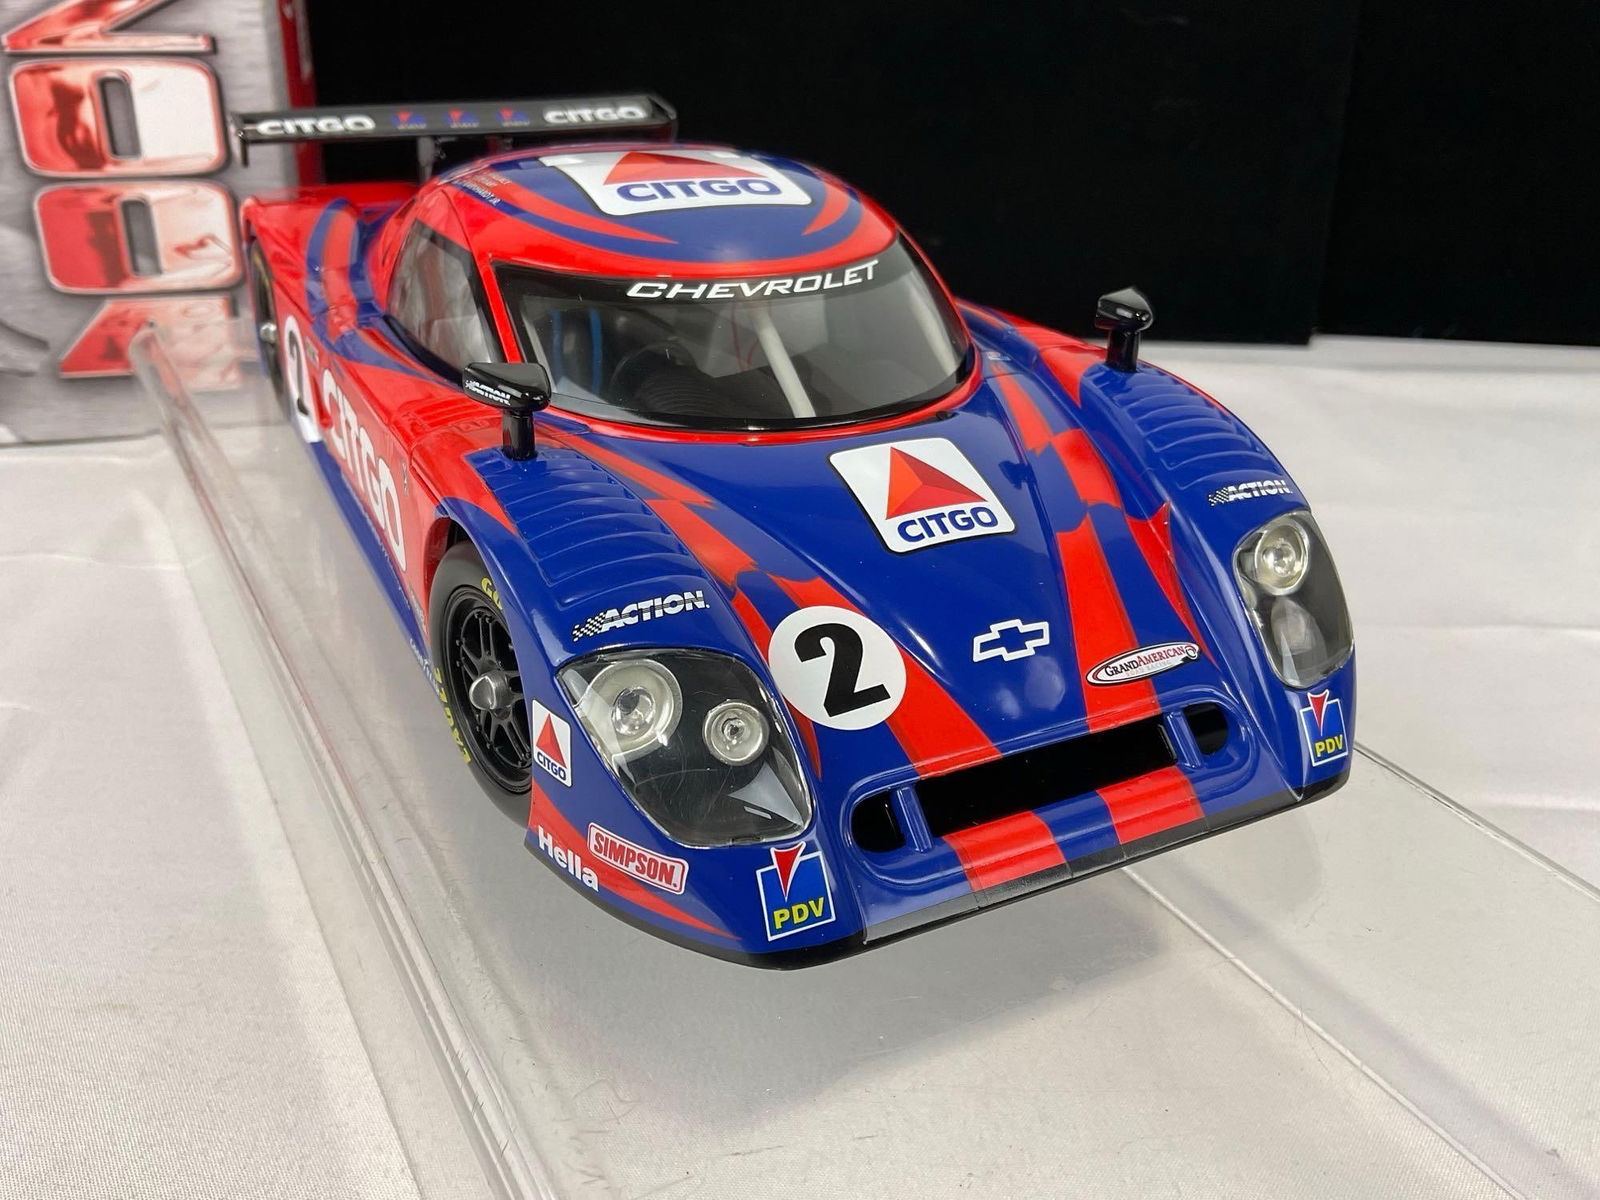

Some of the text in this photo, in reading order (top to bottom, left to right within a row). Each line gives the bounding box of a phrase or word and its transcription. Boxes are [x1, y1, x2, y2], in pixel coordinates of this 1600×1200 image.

[256, 115, 376, 136] CITGO
[544, 105, 647, 124] CITGO
[617, 178, 782, 202] CITGO
[626, 260, 879, 300] CHEVROLET
[289, 331, 309, 416] 2
[322, 368, 406, 572] CITGO
[897, 506, 999, 542] CITGO
[794, 622, 891, 717] 2
[1314, 735, 1344, 758] PDV
[536, 751, 567, 781] CITGO
[537, 825, 599, 892] Hella
[773, 897, 825, 930] PDV
